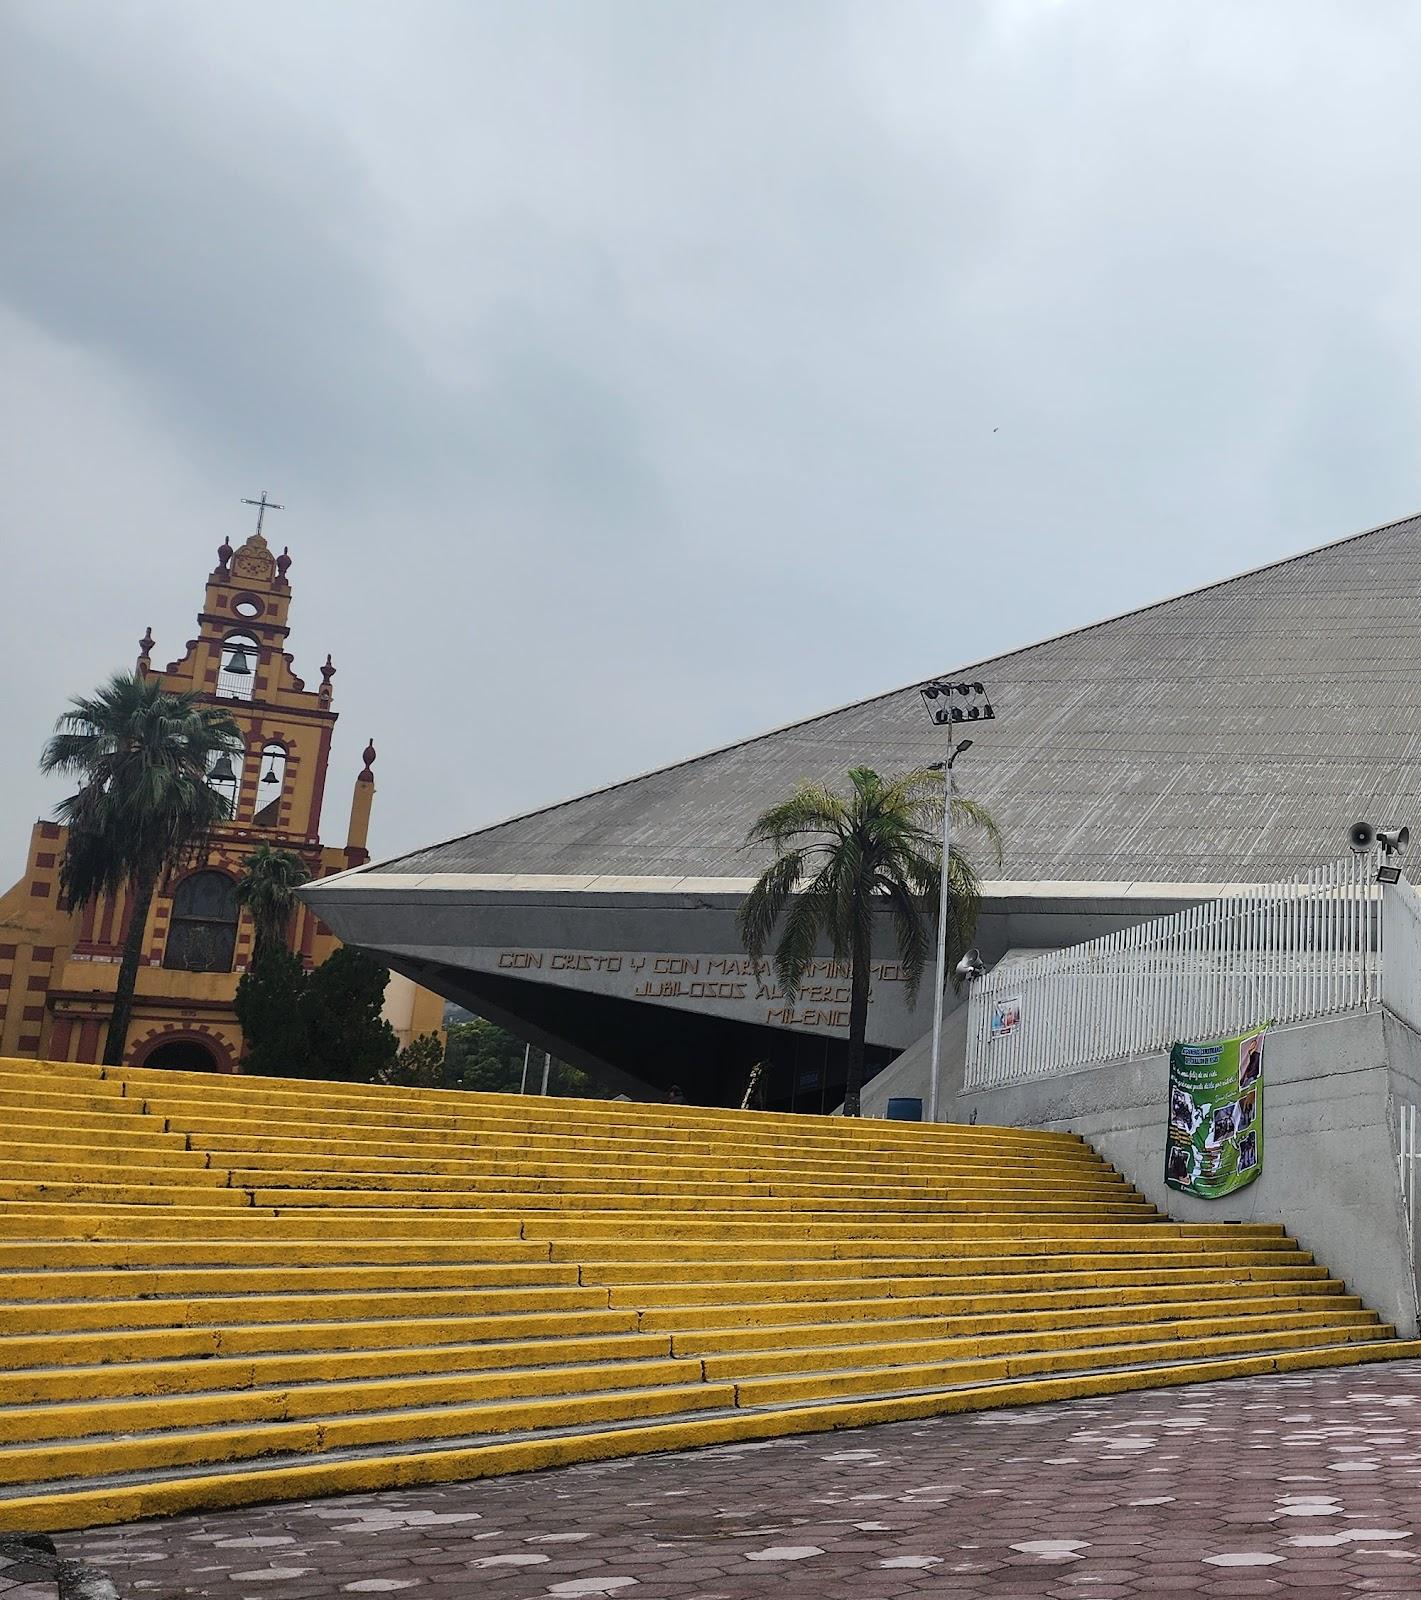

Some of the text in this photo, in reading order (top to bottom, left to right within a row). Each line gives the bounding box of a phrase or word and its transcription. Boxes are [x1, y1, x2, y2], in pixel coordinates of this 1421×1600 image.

[499, 953, 543, 969] CON
[551, 955, 623, 972] CRISTO
[653, 958, 699, 974] CON
[784, 961, 914, 982] AMINMOS
[635, 981, 875, 1004] JUBILOSOS AL TERCR
